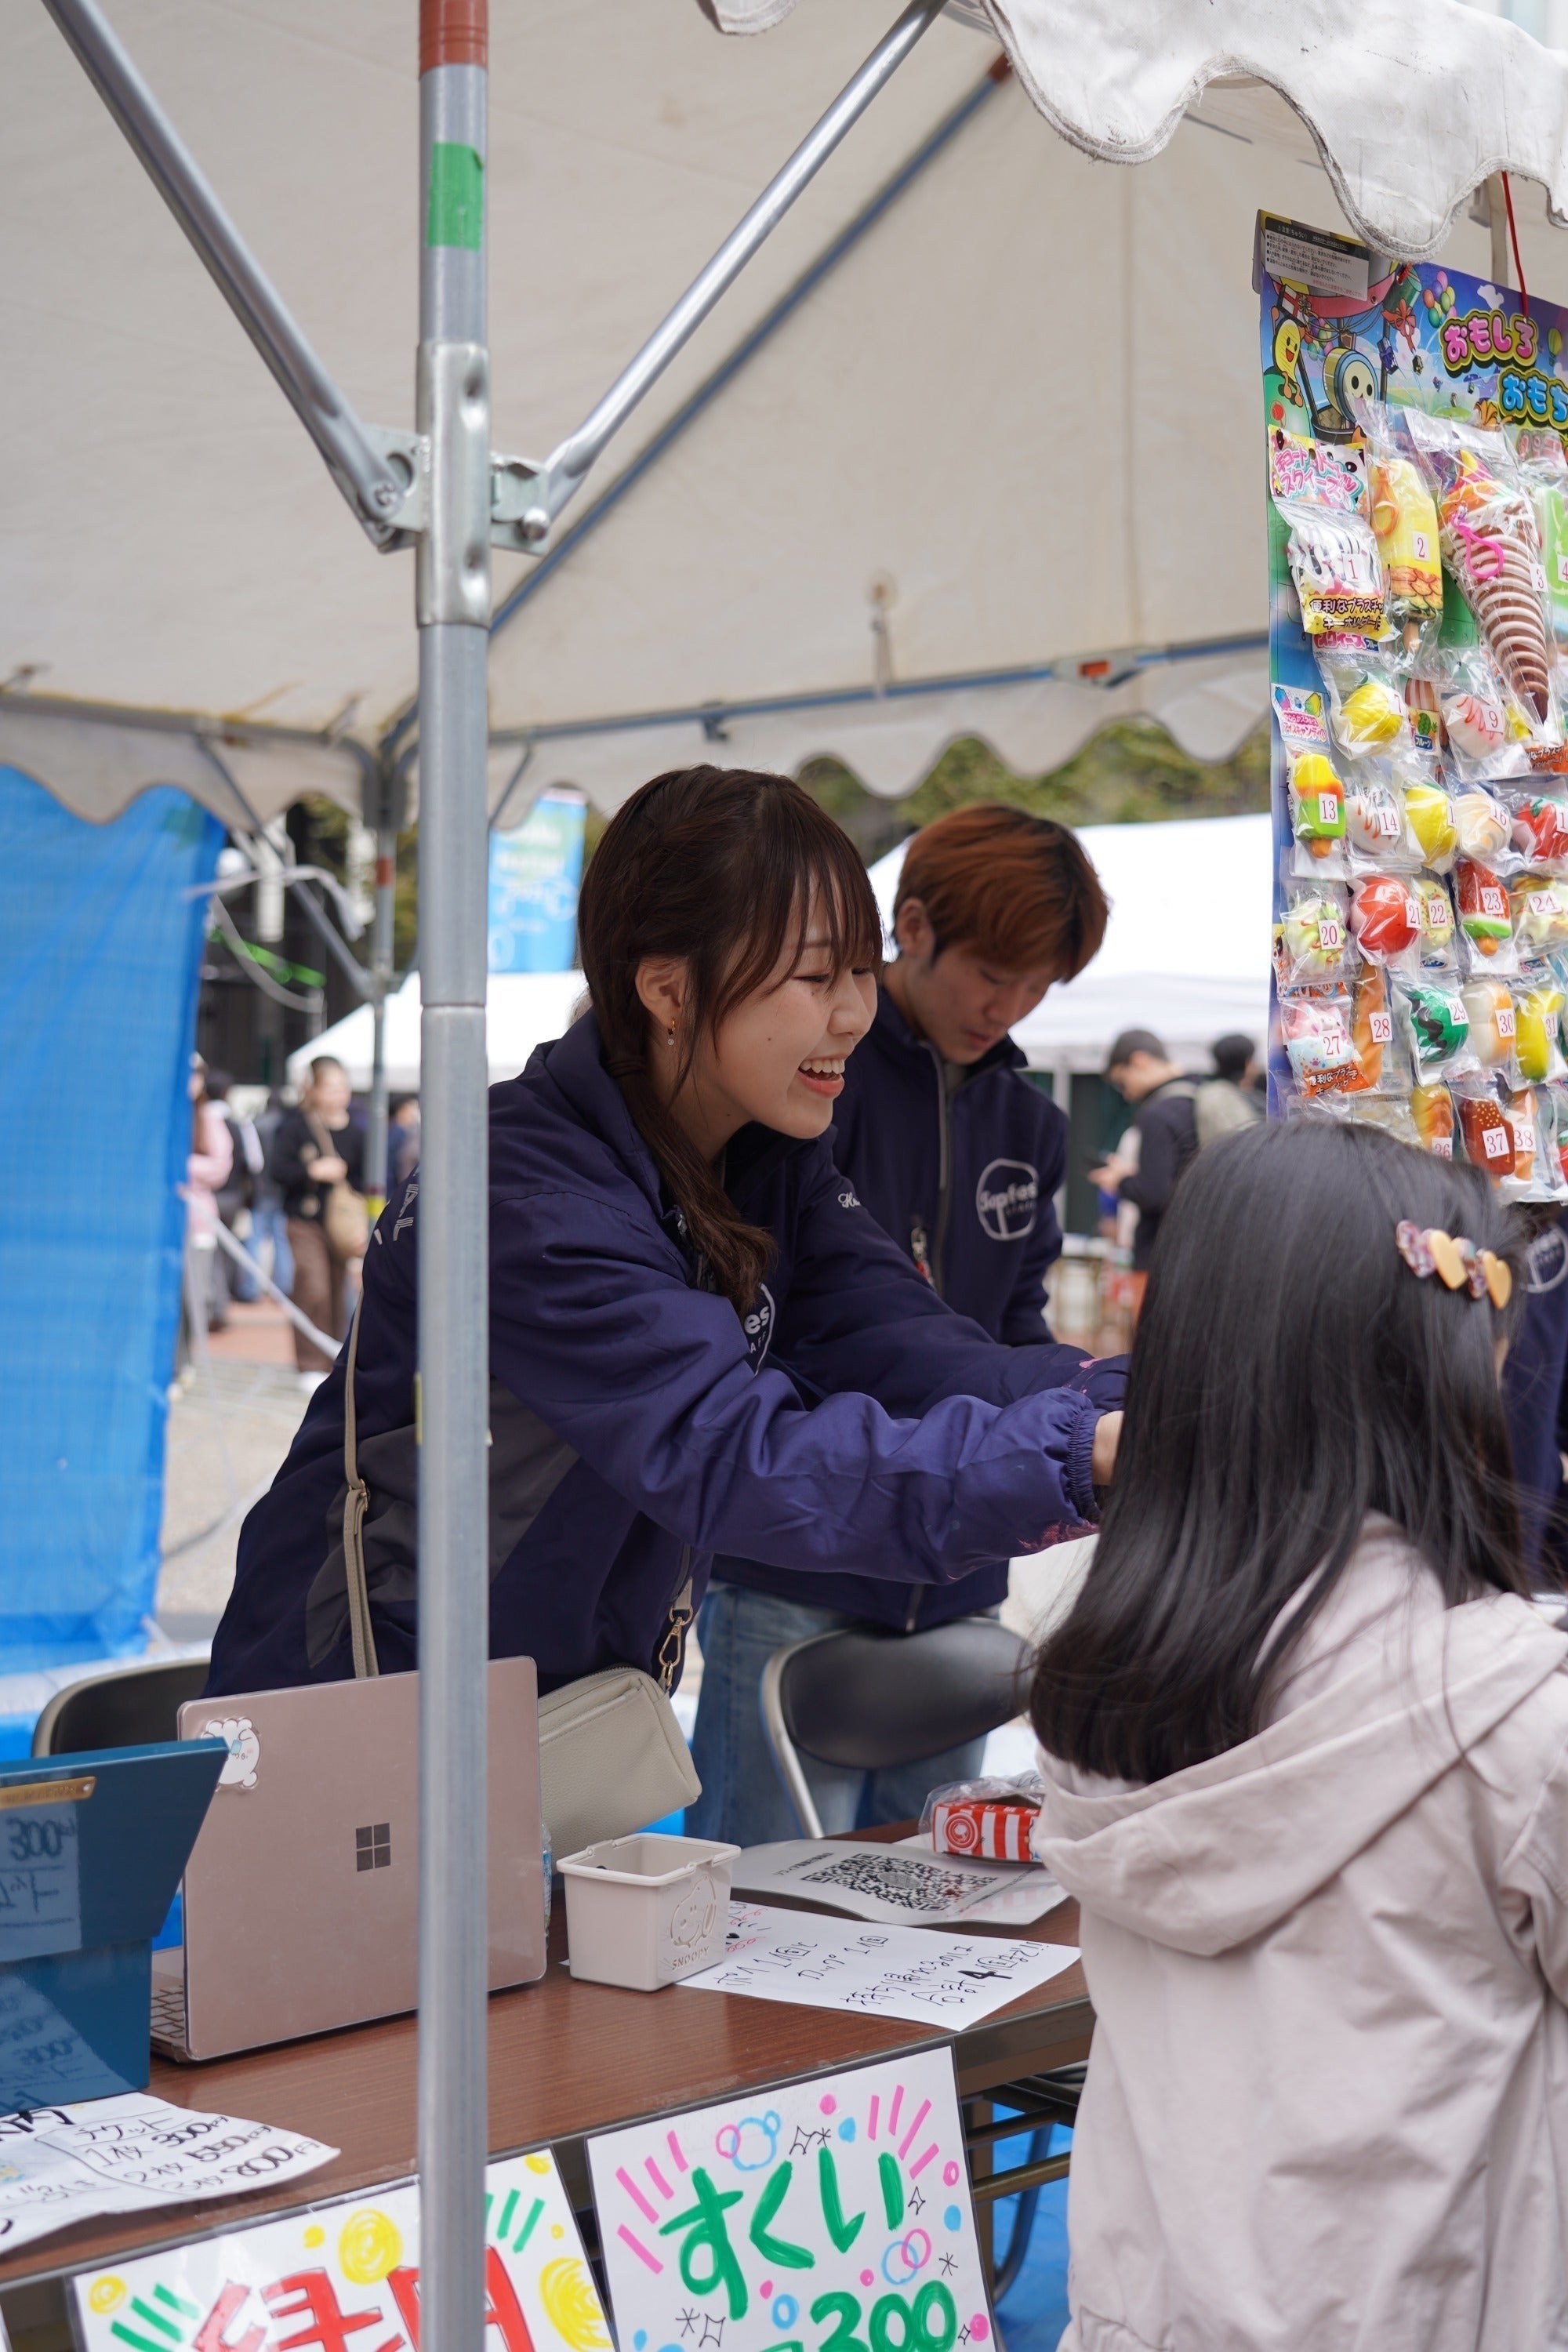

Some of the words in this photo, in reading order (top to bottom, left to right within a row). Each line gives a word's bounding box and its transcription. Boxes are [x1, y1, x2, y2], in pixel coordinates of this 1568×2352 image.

[1444, 315, 1534, 364] おもしろ
[1417, 537, 1426, 558] 2
[1348, 558, 1359, 580] 1
[1393, 694, 1402, 713] 7
[1488, 710, 1499, 729] 9
[1321, 799, 1338, 820] 13
[1494, 807, 1507, 826] 16
[1381, 811, 1399, 831] 14
[1484, 892, 1501, 910] 23
[1532, 895, 1559, 913] 24
[1409, 905, 1421, 925] 21
[1430, 905, 1446, 924] 22
[1321, 925, 1338, 946] 20
[1450, 1002, 1466, 1021] 29
[1374, 1018, 1390, 1039] 28
[1499, 1014, 1514, 1033] 30
[1545, 1016, 1556, 1036] 31
[1323, 1036, 1341, 1055] 27
[1486, 1133, 1504, 1154] 37
[1514, 1130, 1534, 1148] 38
[672, 1945, 710, 1970] SNOOPY
[658, 2146, 905, 2321] すくい
